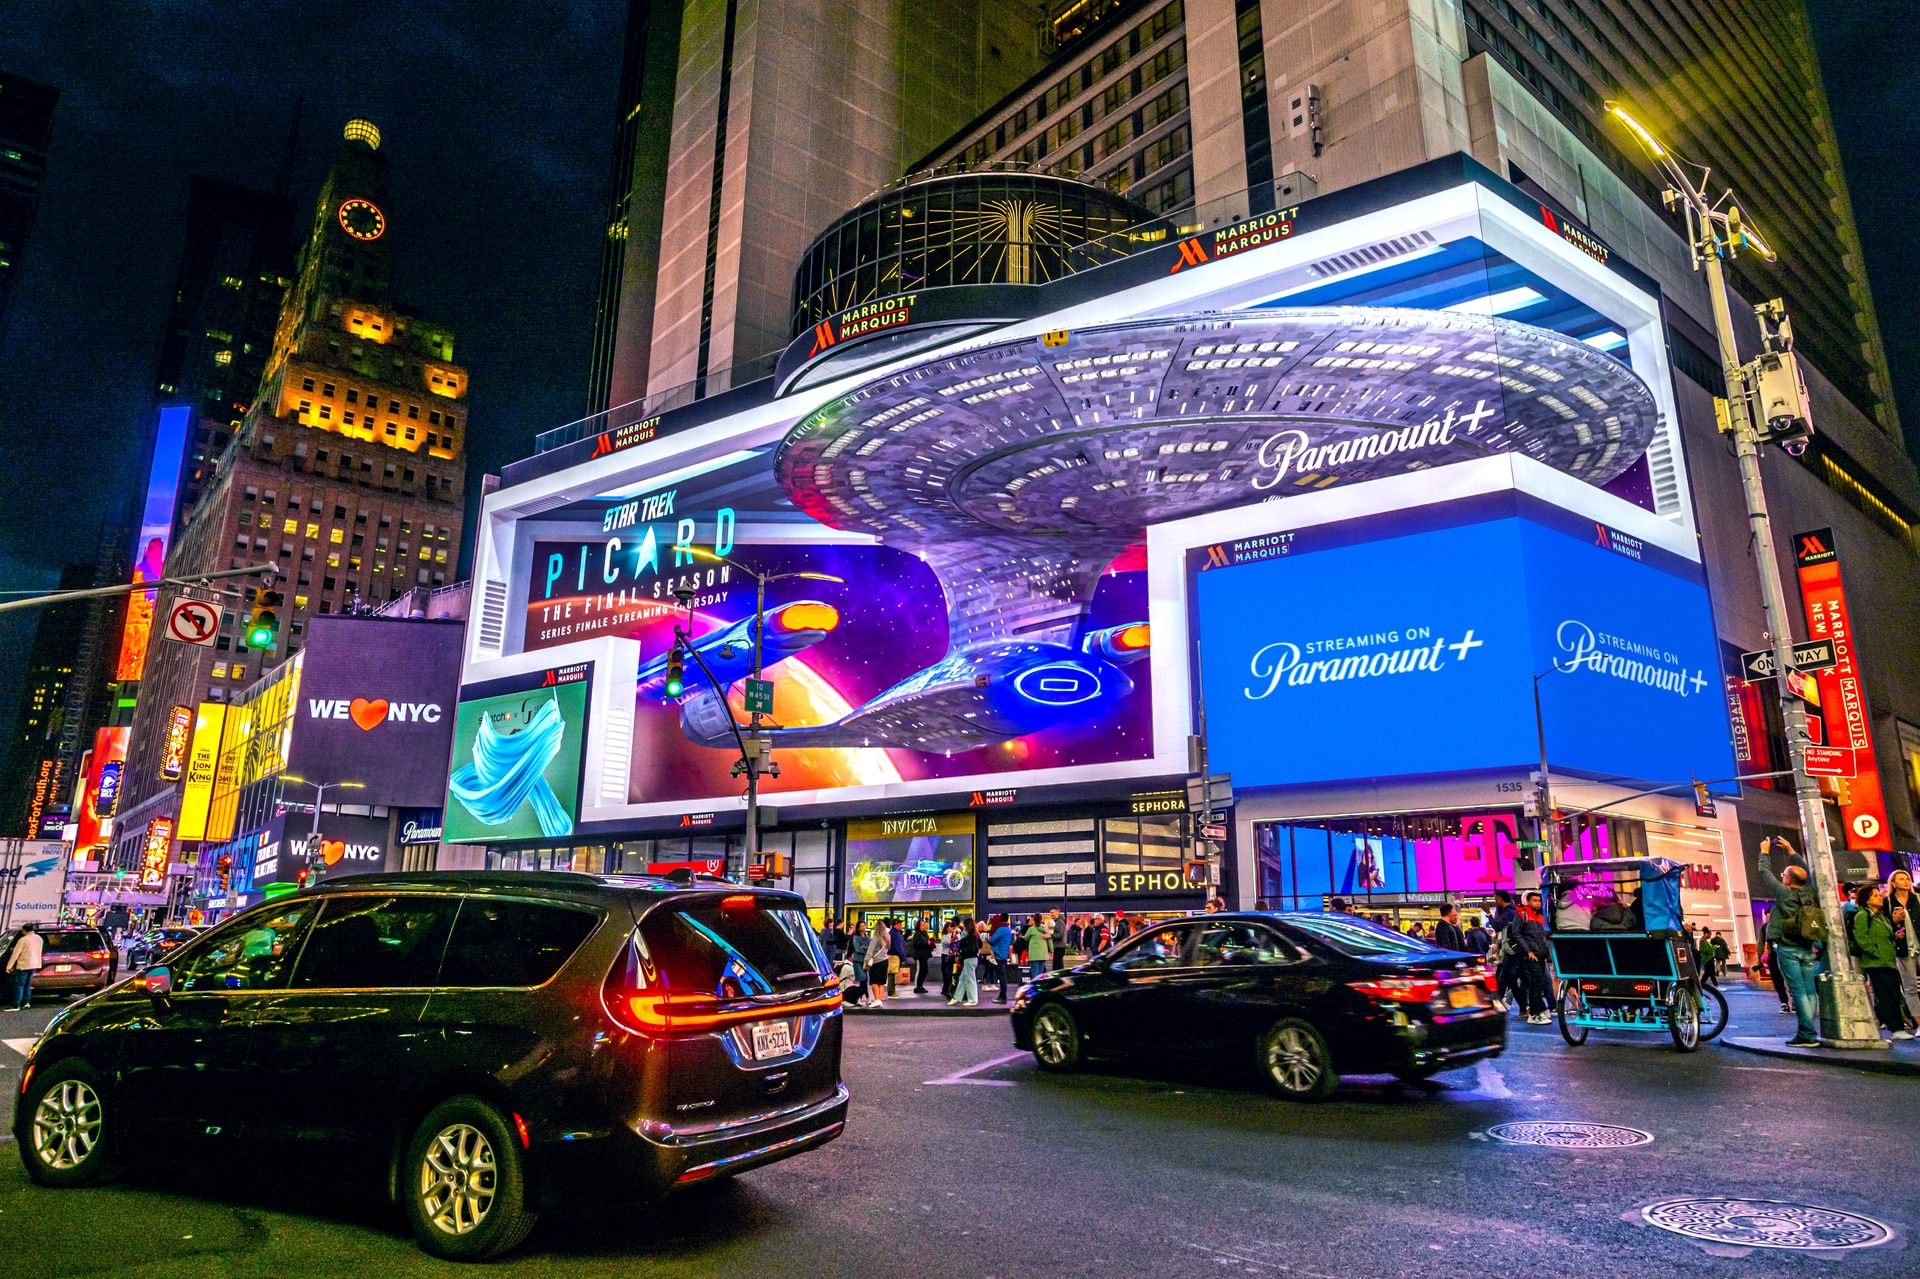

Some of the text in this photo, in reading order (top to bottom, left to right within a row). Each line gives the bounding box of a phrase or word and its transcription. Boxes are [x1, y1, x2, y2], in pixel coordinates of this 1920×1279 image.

[1216, 207, 1298, 241] MARRIOTT
[1216, 223, 1291, 256] MARQUIS
[1563, 222, 1608, 258] MARRIOTT
[842, 295, 917, 322] MARRIOTT
[841, 311, 907, 338] MARQUIS
[616, 416, 661, 438] MARRIOTT
[615, 429, 654, 448] MARQUIS
[1252, 400, 1495, 490] Paramount+
[602, 489, 678, 533] STAR TREK
[1234, 533, 1295, 551] MARRIOTT
[1611, 531, 1643, 550] MARRIOTT
[1612, 542, 1641, 559] MARQUIS
[1235, 545, 1288, 562] MARQUIS
[1804, 551, 1835, 561] MARRIOTT
[543, 566, 731, 623] THE FINAL SEASON
[541, 624, 573, 640] SERIES
[575, 618, 609, 633] FINALE
[612, 605, 669, 625] STREAMING
[1811, 603, 1828, 633] NEW
[1306, 626, 1431, 655] STREAMING ON
[1598, 632, 1680, 666] STREAMING ON
[1244, 629, 1484, 701] Paramount+
[1556, 619, 1708, 698] Paramount+
[1758, 649, 1822, 670] ON WAY
[558, 672, 584, 682] MARQUIS
[559, 664, 588, 675] MARRIOTT
[1828, 600, 1852, 674] MARRIOTT
[1843, 680, 1866, 748] MARQUIS
[754, 691, 763, 700] 45
[763, 693, 770, 701] St
[756, 682, 764, 691] TO
[309, 699, 441, 724] WE NYC
[1807, 755, 1830, 763] Anytime
[986, 789, 1017, 797] MARRIOTT
[1495, 782, 1523, 793] 1535
[1132, 800, 1185, 812] SEPHORA
[401, 821, 442, 843] Paramoun
[882, 817, 937, 835] INVICTA
[1861, 820, 1871, 833] P
[344, 846, 380, 861] NYC
[910, 875, 930, 884] BWT
